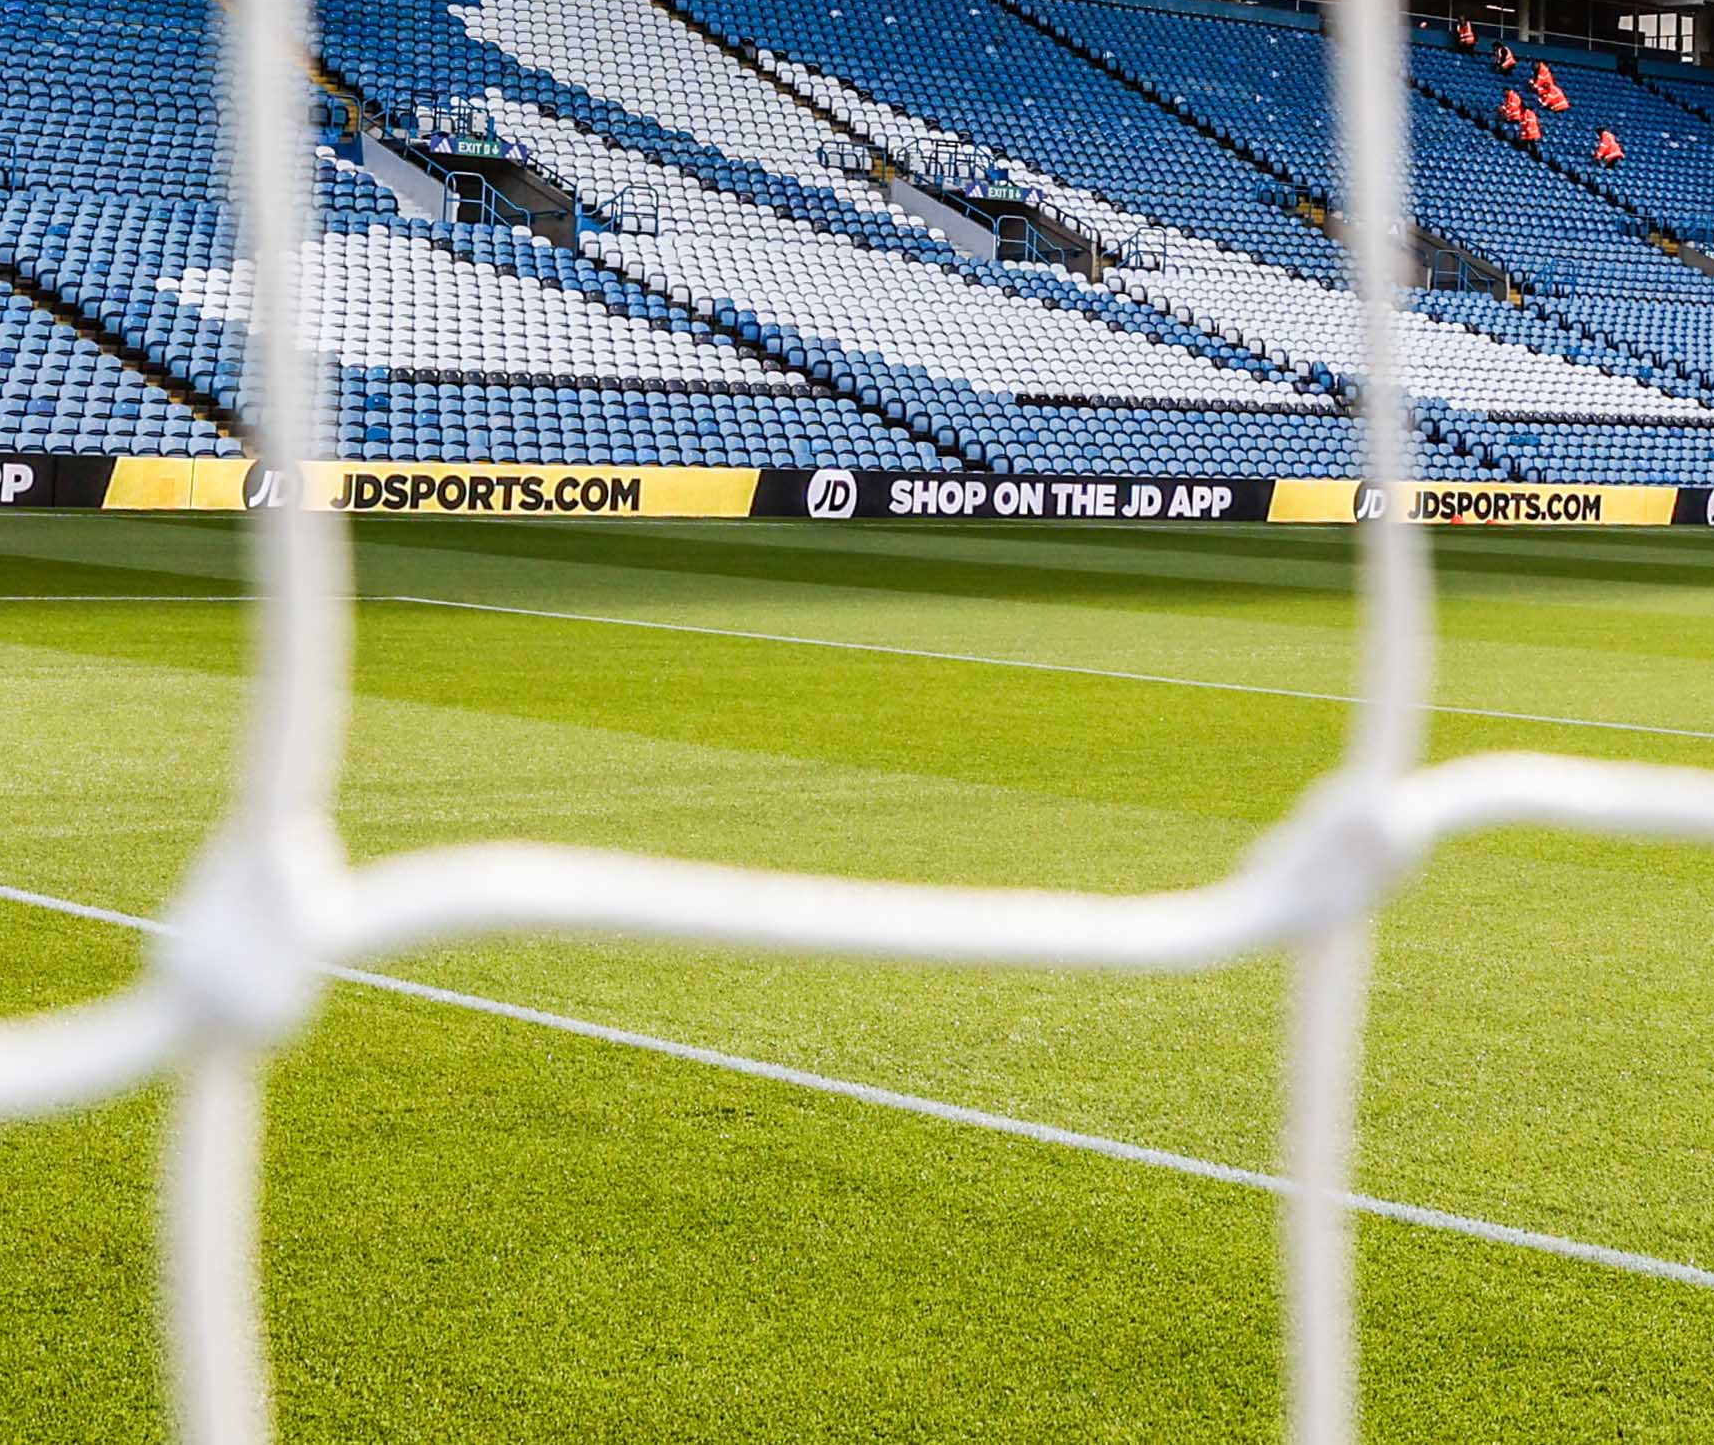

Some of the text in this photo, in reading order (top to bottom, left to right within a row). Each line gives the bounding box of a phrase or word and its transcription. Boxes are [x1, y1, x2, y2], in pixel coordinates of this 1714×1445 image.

[458, 141, 481, 154] EXIT
[331, 474, 639, 511] JDSPORTS.COM
[814, 479, 1232, 517] JD SHOP ON THE JD APP
[1408, 492, 1601, 521] JDSPORTS.COM
